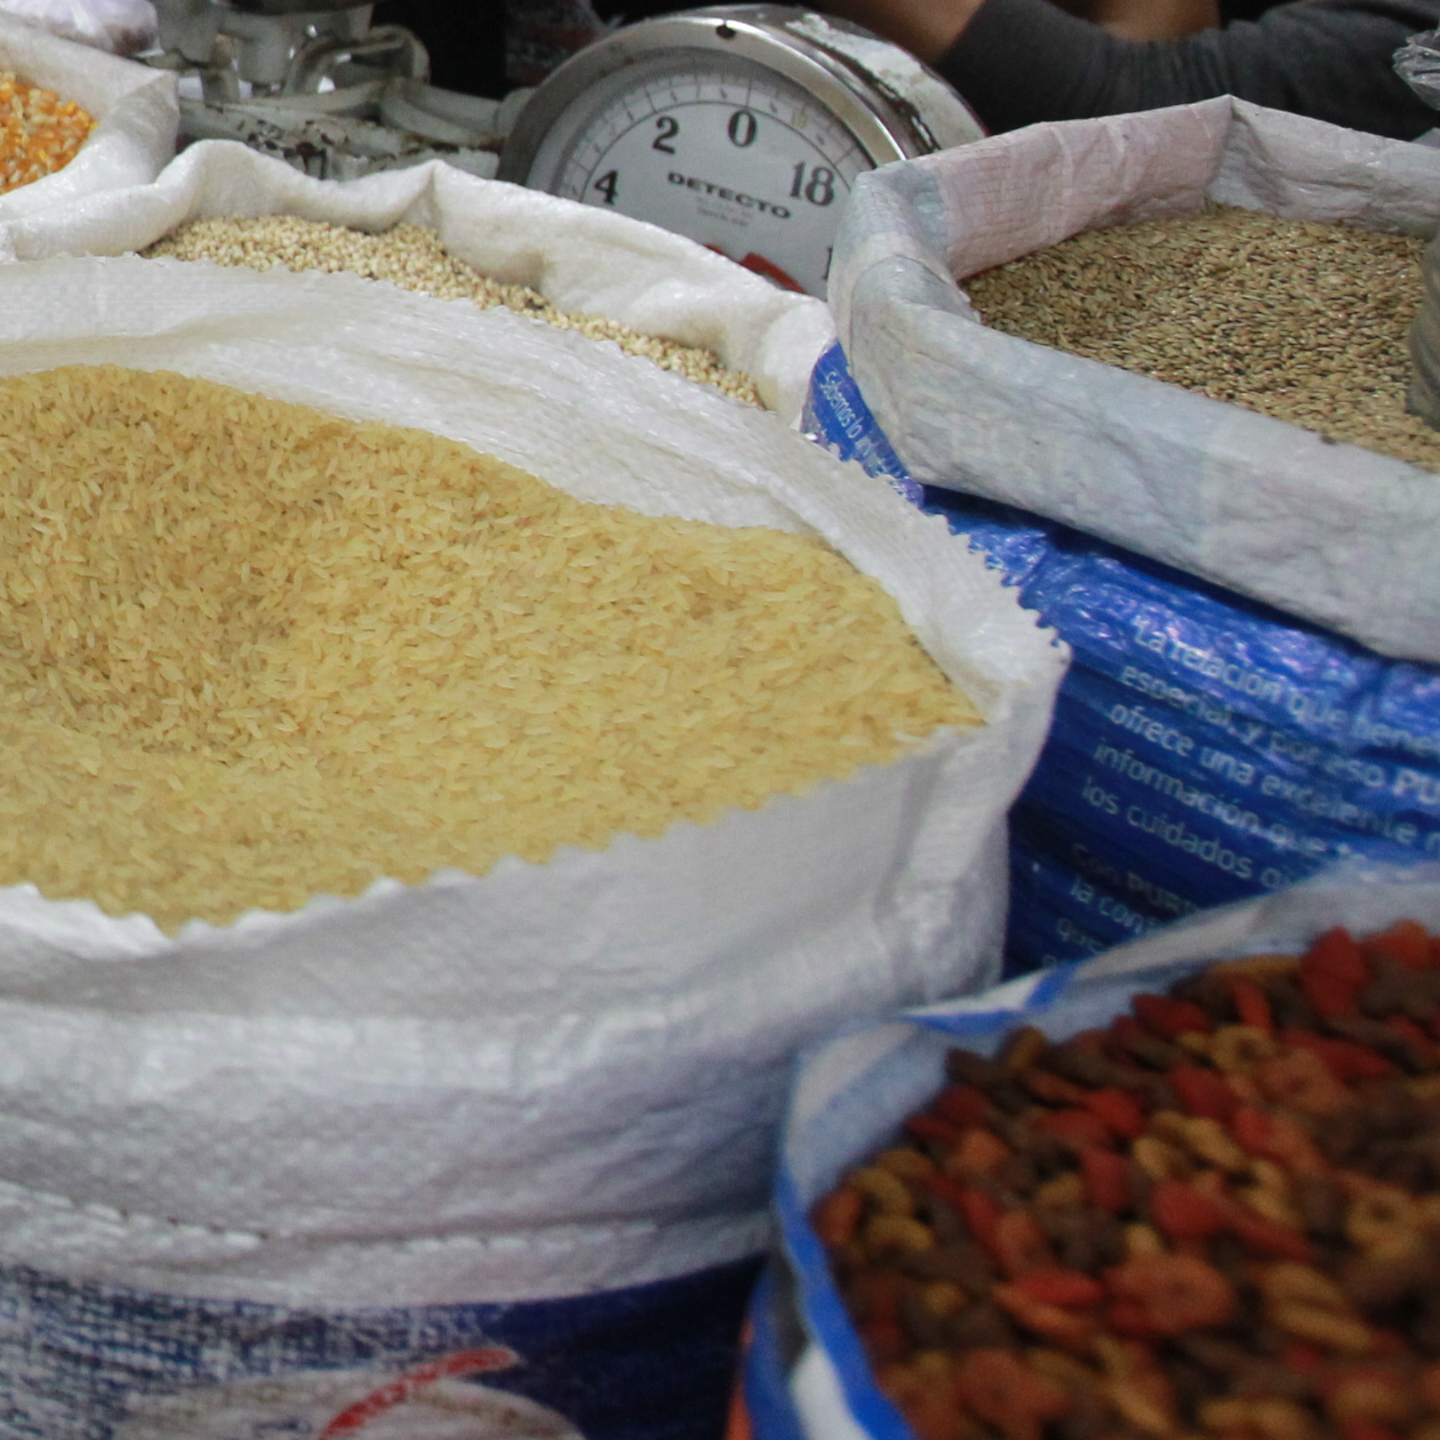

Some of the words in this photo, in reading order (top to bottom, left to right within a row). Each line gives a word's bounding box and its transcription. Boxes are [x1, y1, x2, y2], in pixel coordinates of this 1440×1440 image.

[652, 116, 680, 155] 2
[727, 109, 758, 148] 0
[594, 169, 619, 206] 4
[789, 160, 836, 207] 18
[667, 171, 792, 219] DETECTO
[1170, 640, 1283, 705] relación
[1353, 708, 1440, 758] tiene
[1109, 702, 1196, 758] ofrece
[1200, 744, 1255, 787] una
[1092, 736, 1261, 829] información
[1080, 775, 1121, 816] los
[1125, 803, 1255, 880] cuidados
[1098, 895, 1160, 935] con
